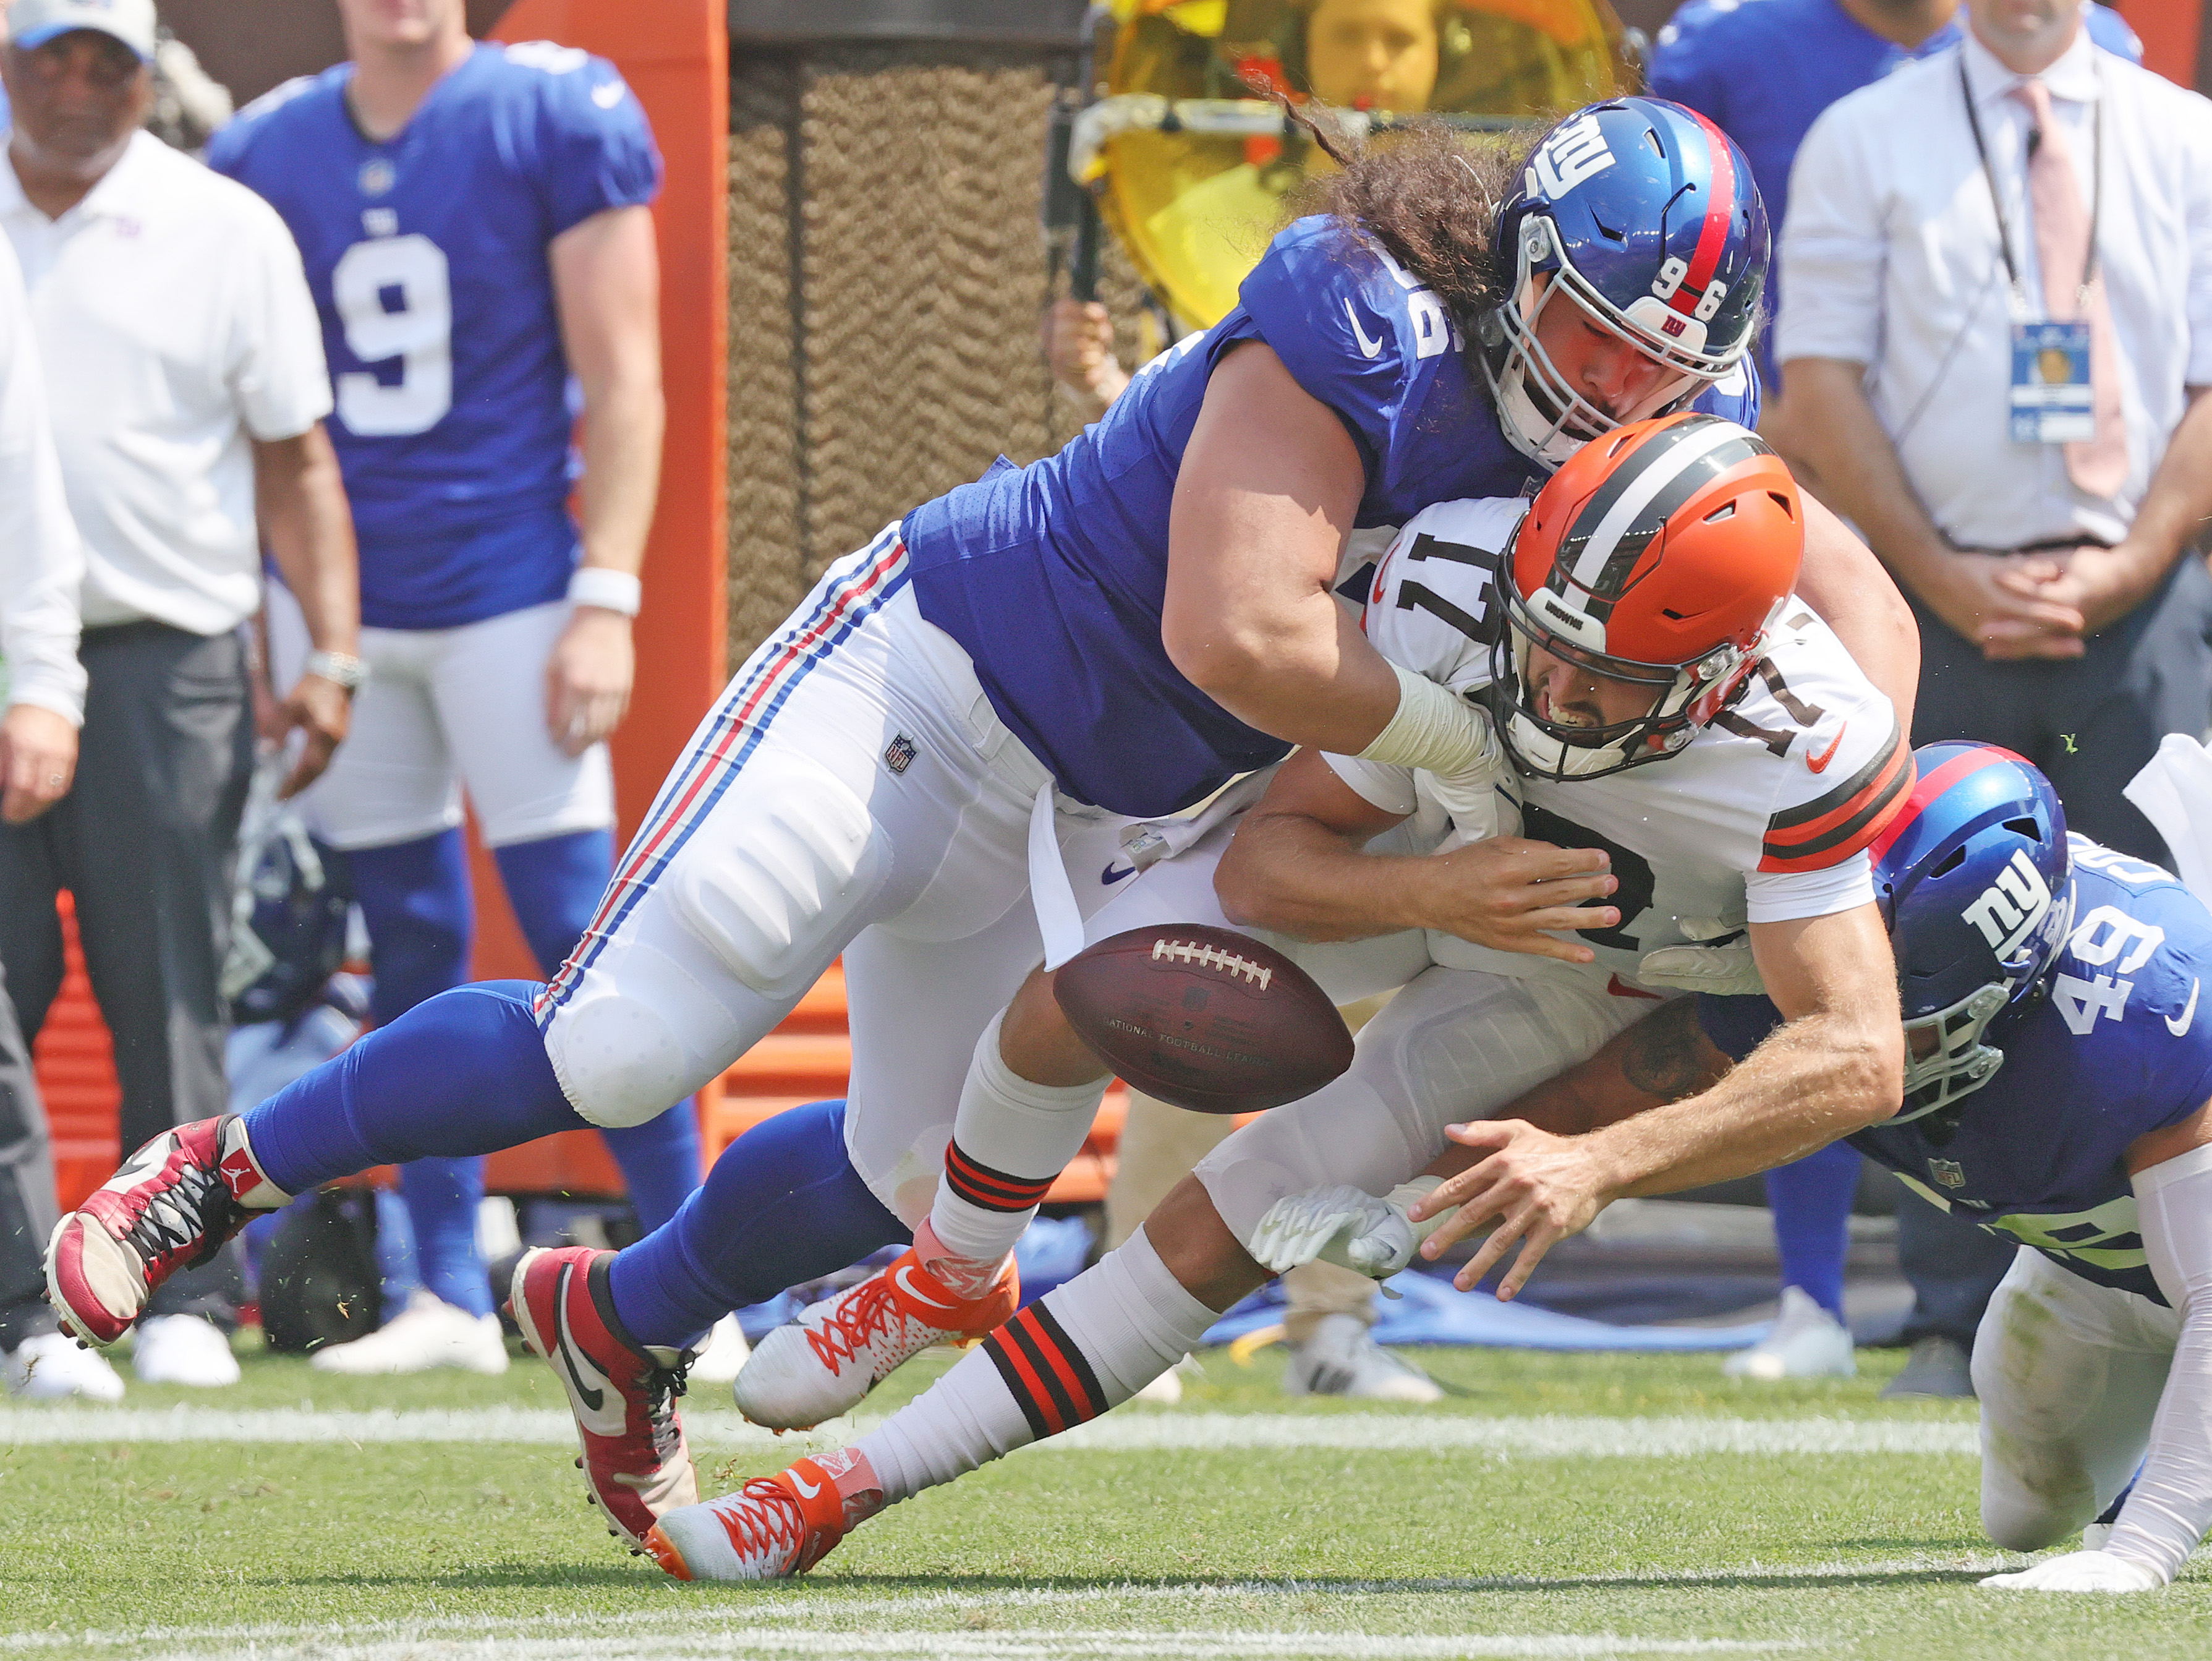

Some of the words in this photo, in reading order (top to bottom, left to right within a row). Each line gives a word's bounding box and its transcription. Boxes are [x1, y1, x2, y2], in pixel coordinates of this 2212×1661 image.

[332, 233, 453, 436] 9
[1396, 532, 1504, 646] 17
[2051, 905, 2165, 1035] 49
[1102, 1015, 1154, 1039] NATIONAL
[1160, 1033, 1221, 1058] FOOTBALL
